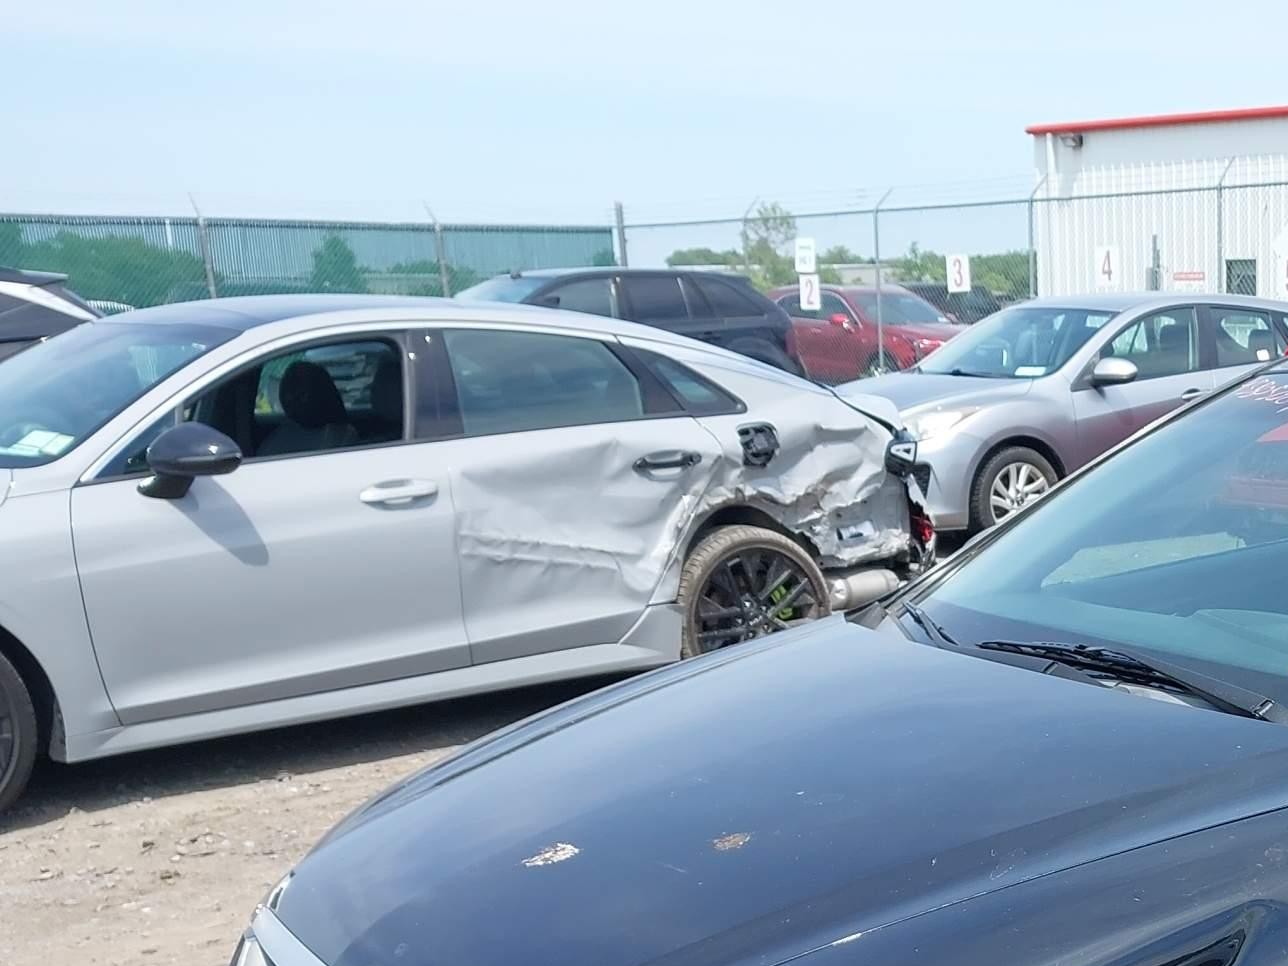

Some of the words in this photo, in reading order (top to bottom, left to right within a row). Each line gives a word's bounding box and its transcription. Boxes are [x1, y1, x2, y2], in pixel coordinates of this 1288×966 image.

[953, 257, 963, 287] 3
[1102, 250, 1112, 281] 4
[805, 278, 814, 305] 2
